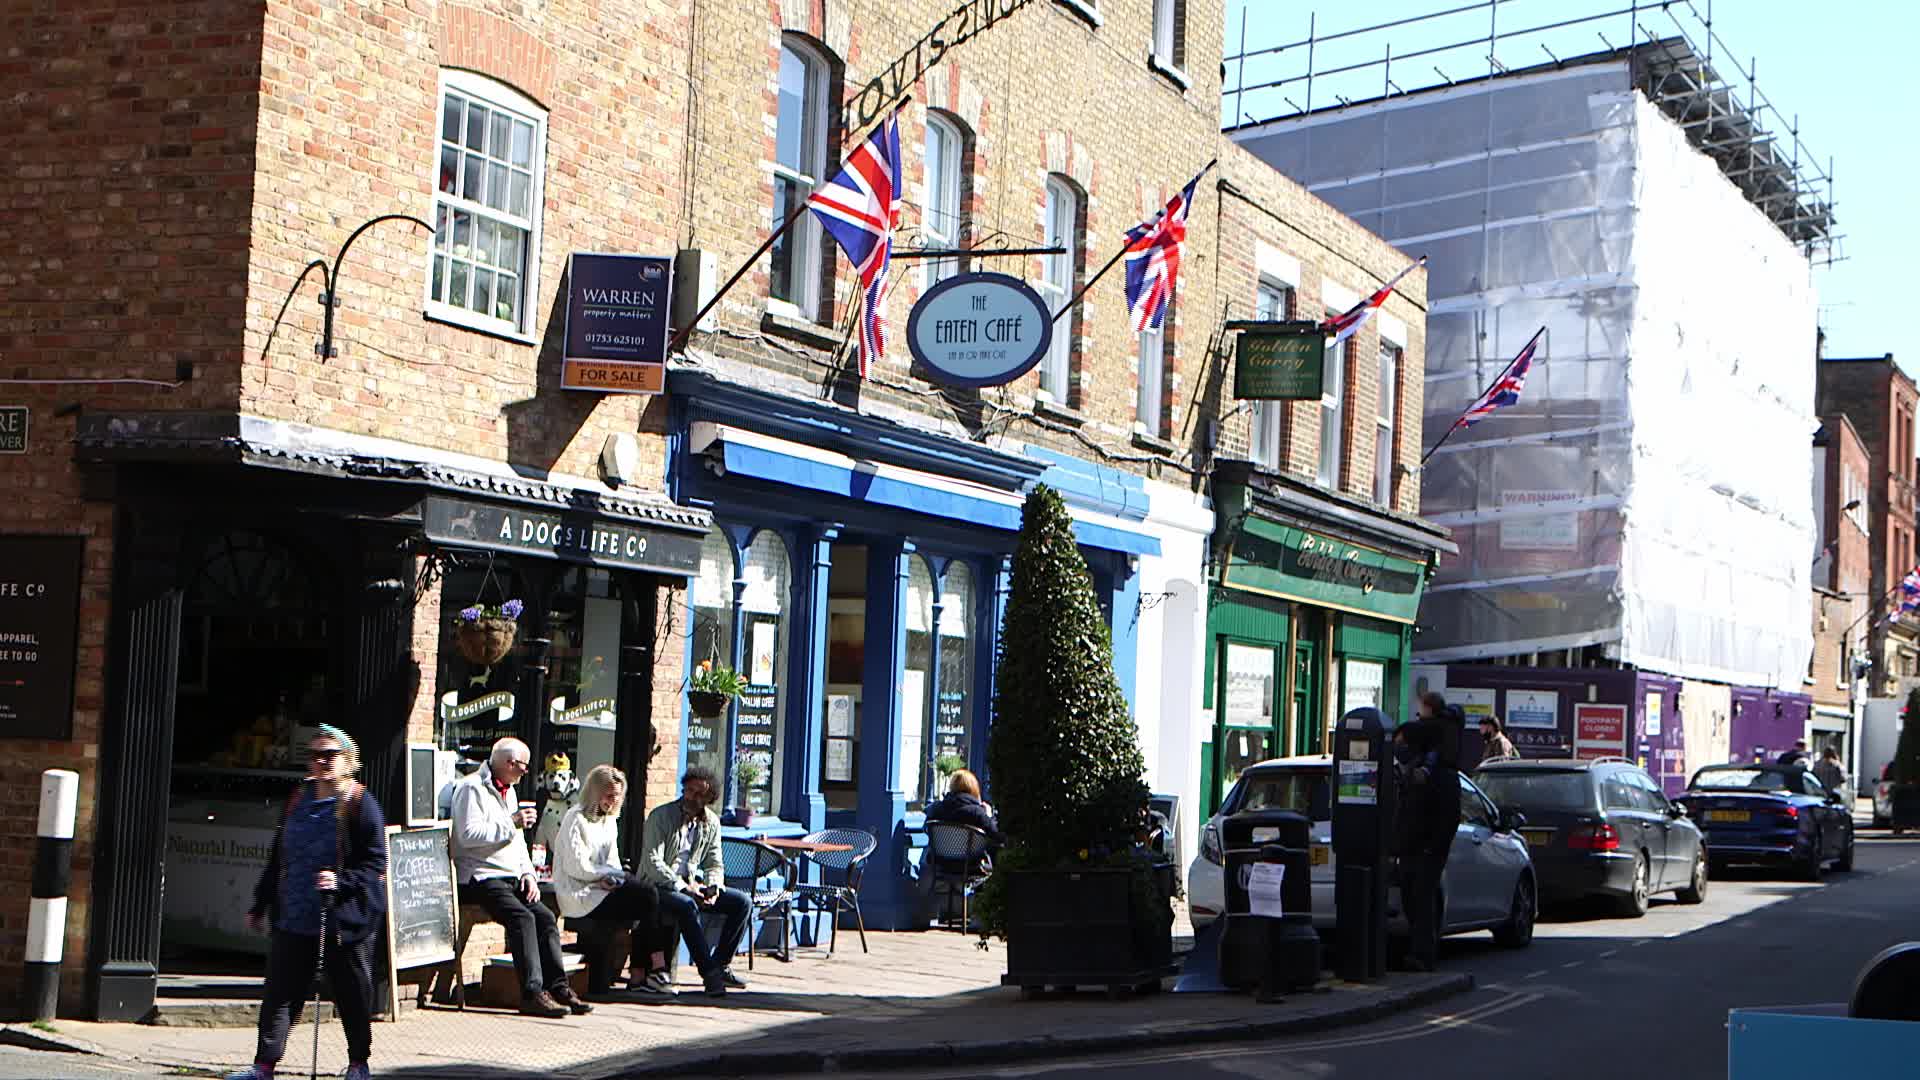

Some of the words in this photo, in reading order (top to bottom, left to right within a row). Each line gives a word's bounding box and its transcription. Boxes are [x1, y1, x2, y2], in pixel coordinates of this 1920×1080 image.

[583, 288, 655, 305] WARREN
[972, 295, 987, 311] THE
[583, 309, 617, 320] property
[620, 312, 652, 320] matters
[936, 320, 977, 343] EATEN
[984, 315, 1022, 342] CAFÉ
[585, 333, 613, 343] 01753
[613, 335, 645, 345] 625101
[580, 369, 607, 381] FOR
[611, 371, 645, 383] SALE
[500, 516, 511, 539] A
[580, 528, 619, 555] LIFE
[12, 650, 22, 661] TO
[25, 651, 37, 661] GO
[451, 709, 457, 718] A
[479, 696, 495, 710] LIFE
[559, 712, 564, 721] A
[583, 702, 598, 714] LIFE
[395, 857, 435, 879] COFFEE
